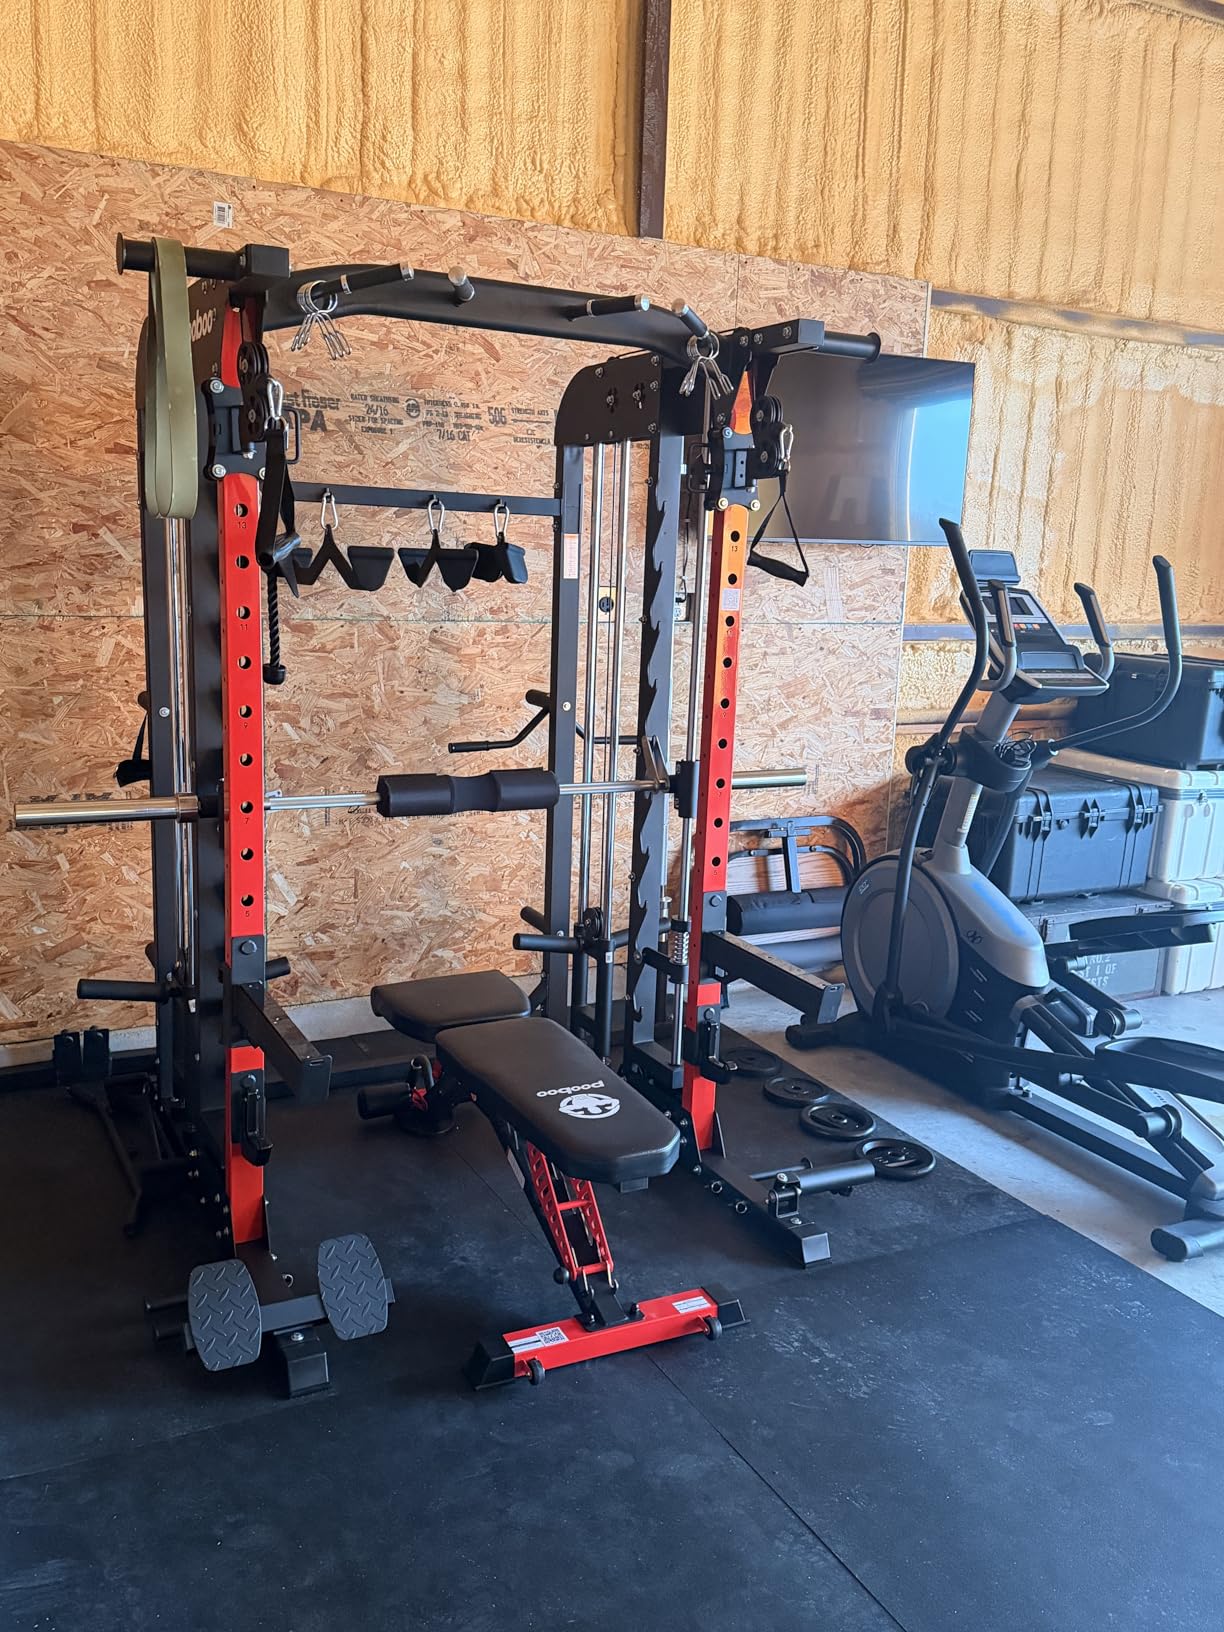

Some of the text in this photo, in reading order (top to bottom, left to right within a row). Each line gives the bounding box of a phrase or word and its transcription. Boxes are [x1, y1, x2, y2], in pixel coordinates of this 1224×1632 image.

[365, 404, 389, 417] 24/16
[436, 429, 456, 441] 7/16
[237, 521, 247, 529] 13
[536, 1080, 605, 1098] pooboo
